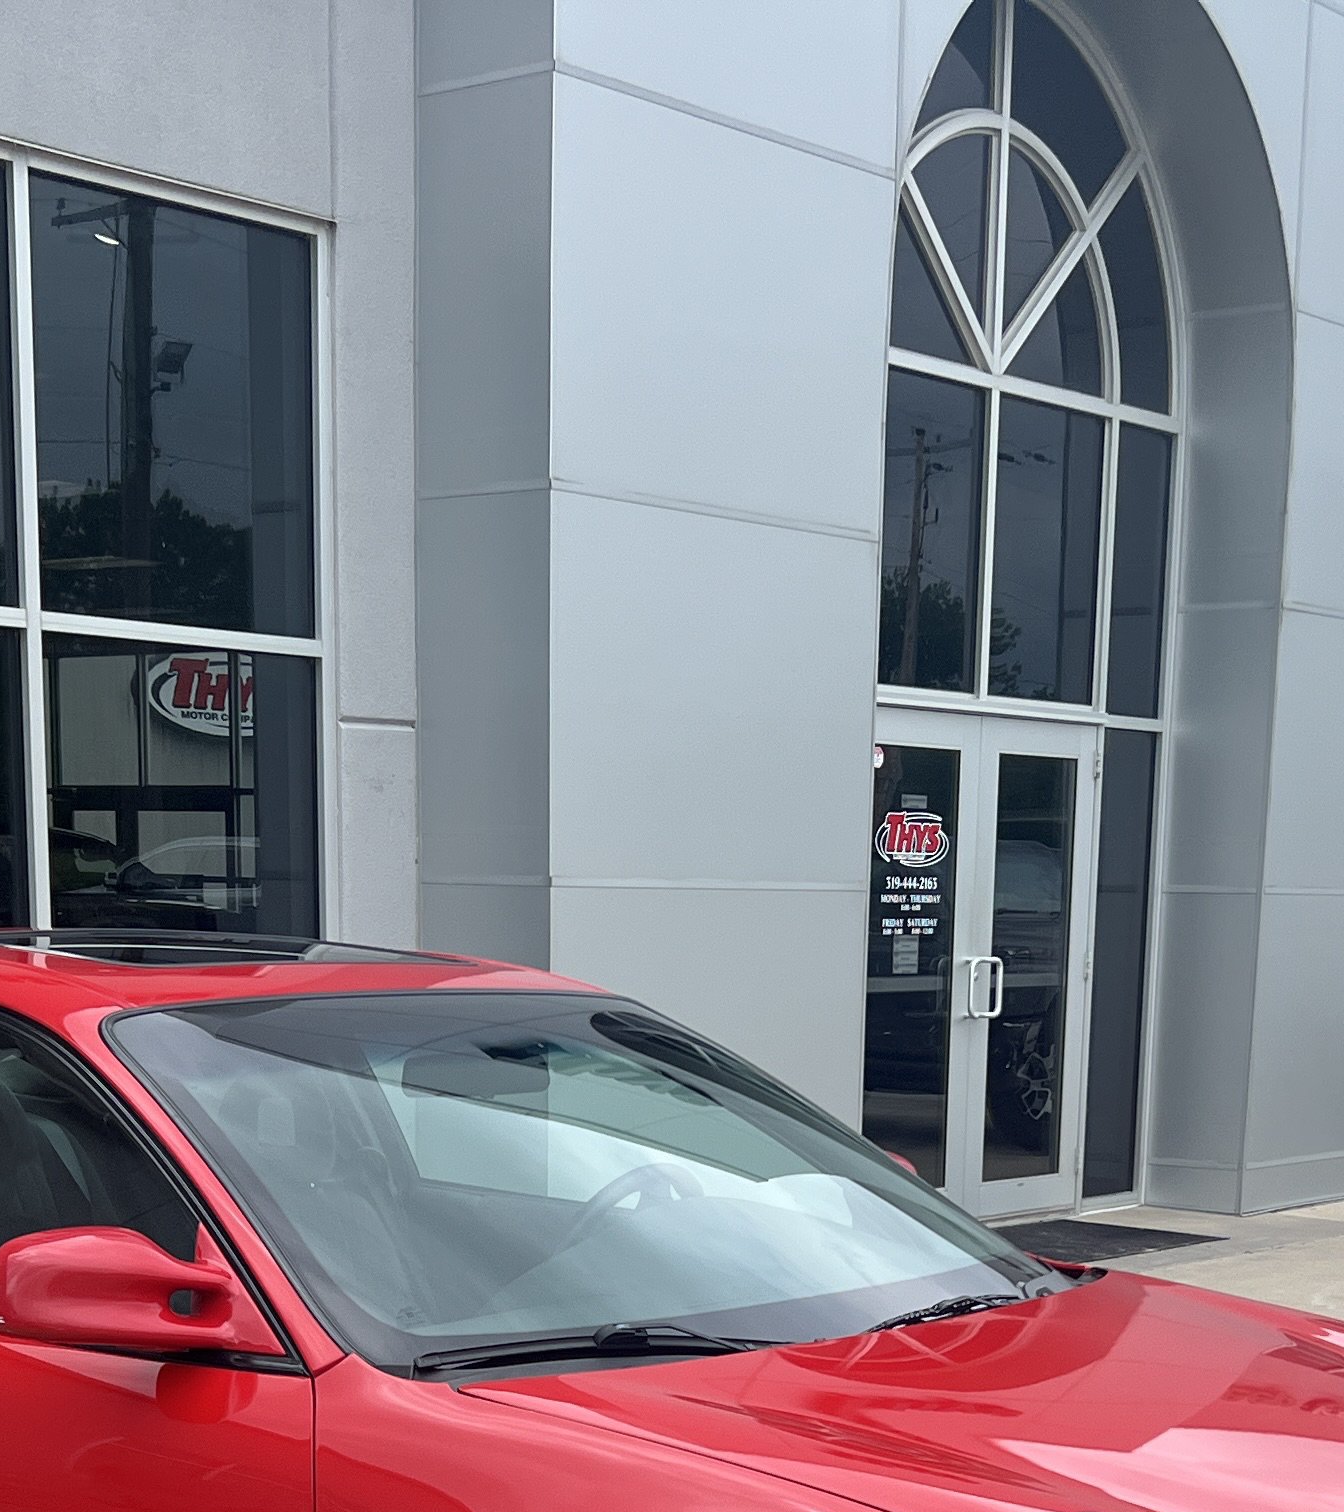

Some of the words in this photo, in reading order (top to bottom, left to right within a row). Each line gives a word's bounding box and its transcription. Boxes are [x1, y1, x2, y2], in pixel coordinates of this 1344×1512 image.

[180, 710, 219, 721] MOTOR
[884, 811, 942, 855] THYS
[885, 876, 938, 890] 319-444-2163
[880, 894, 907, 903] MONDAY
[910, 894, 942, 903] THURSDAY
[881, 918, 905, 928] FRIDAY
[907, 918, 938, 927] SATURDAY
